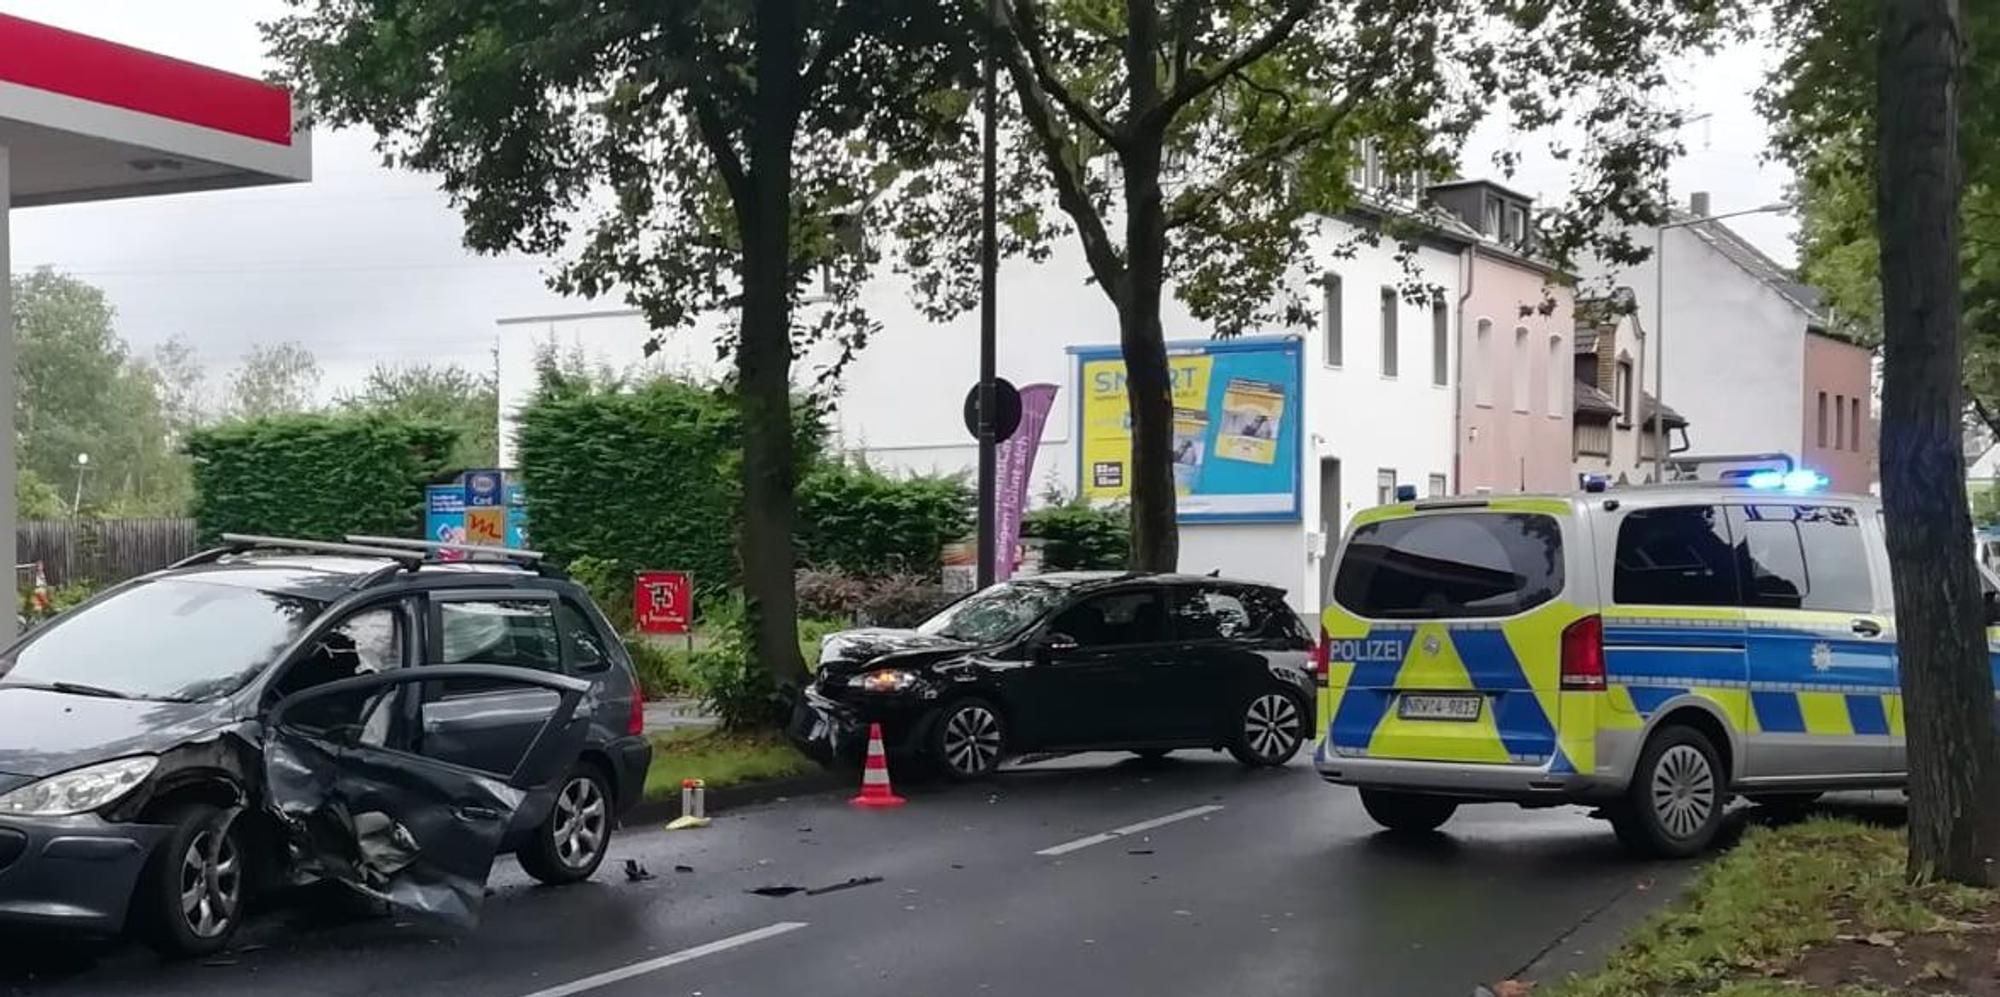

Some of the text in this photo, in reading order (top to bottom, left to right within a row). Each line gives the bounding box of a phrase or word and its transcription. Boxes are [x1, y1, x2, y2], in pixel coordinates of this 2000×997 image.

[1002, 469, 1022, 509] lohnt
[1013, 435, 1029, 465] sich
[1330, 639, 1403, 662] POLIZEI
